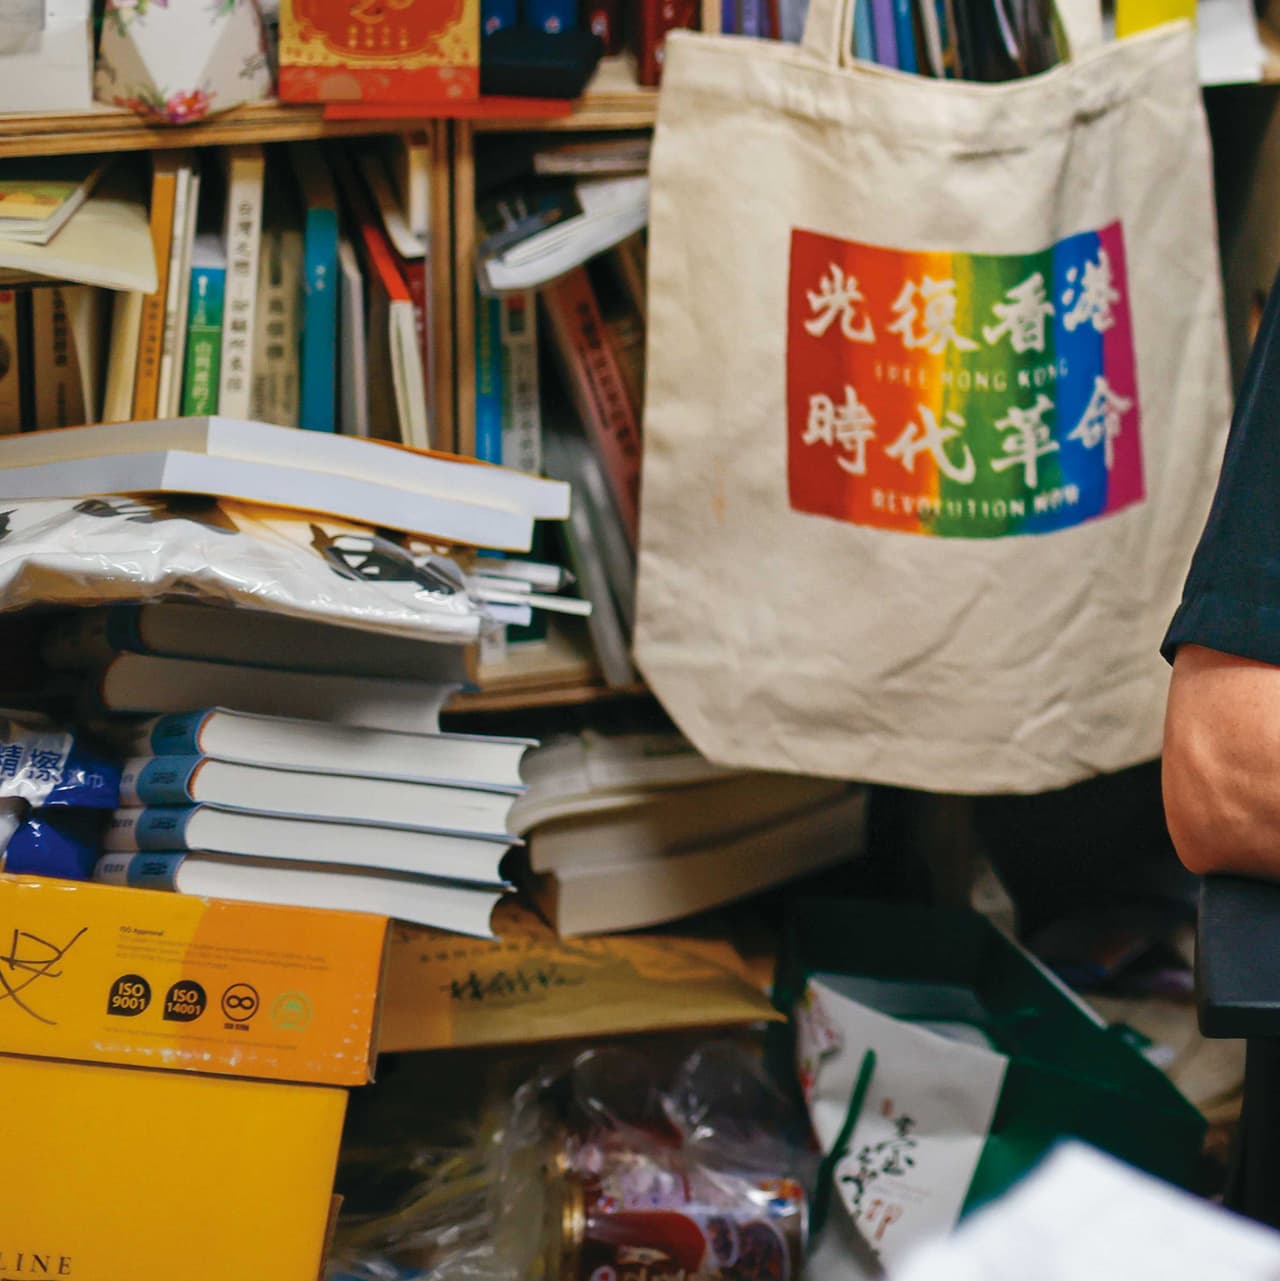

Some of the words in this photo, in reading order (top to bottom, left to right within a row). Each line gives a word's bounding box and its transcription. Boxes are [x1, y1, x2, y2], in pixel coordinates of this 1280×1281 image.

[804, 246, 1120, 356] 光復香港
[941, 371, 1007, 391] HONG
[1018, 361, 1068, 388] KONG
[802, 374, 1131, 489] 時代革命
[872, 489, 1025, 519] REVOLUTION
[1034, 484, 1080, 513] NOW
[119, 983, 144, 997] ISO
[173, 989, 198, 1004] ISO
[111, 996, 146, 1010] 9001
[167, 1002, 201, 1015] 14001
